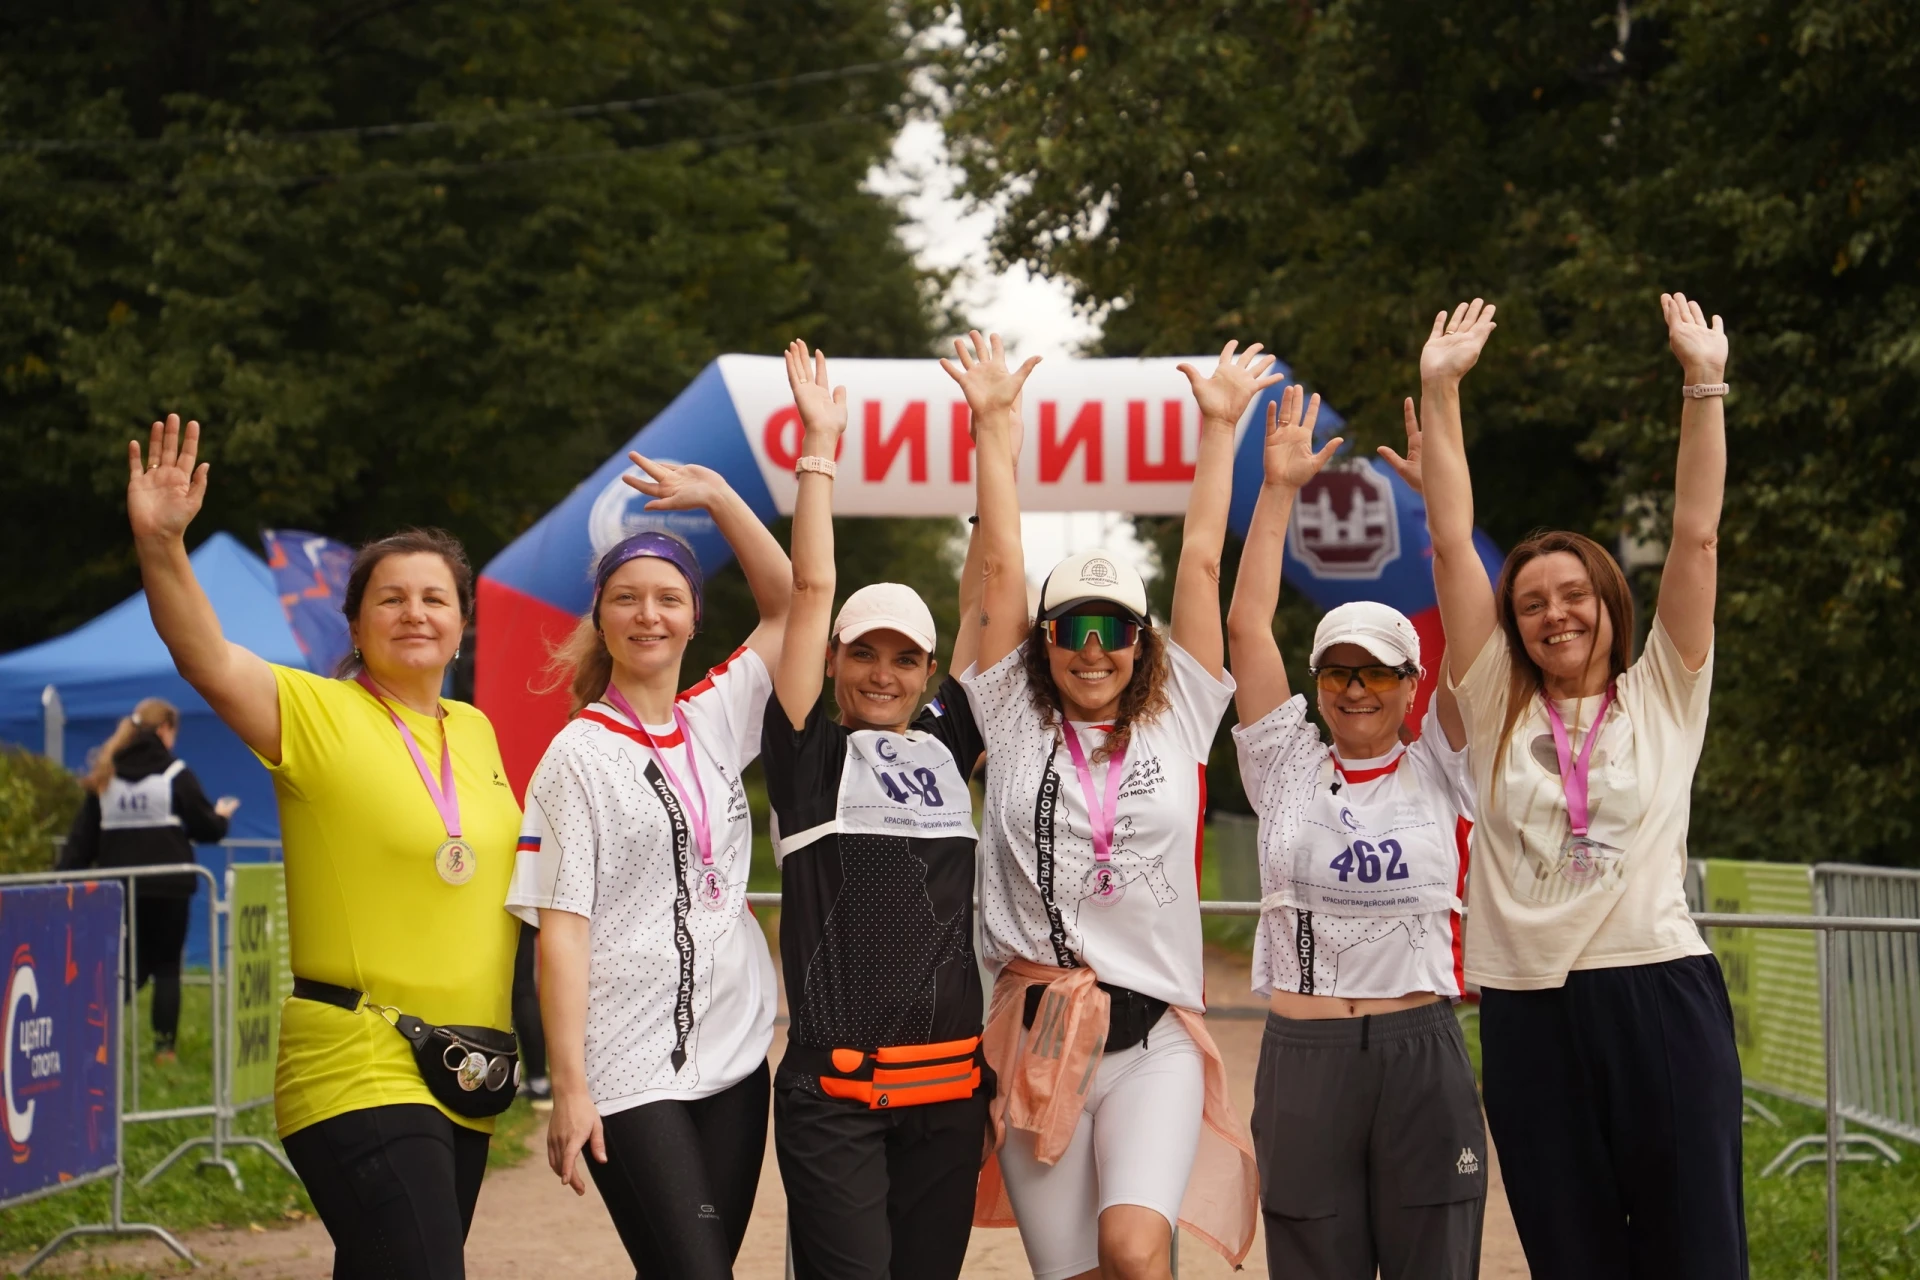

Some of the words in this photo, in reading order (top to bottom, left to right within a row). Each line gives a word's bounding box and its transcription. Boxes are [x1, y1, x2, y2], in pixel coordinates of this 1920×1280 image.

[654, 777, 685, 830] РАЙОНА
[1128, 779, 1154, 788] БОЛШЕ
[884, 816, 942, 828] КРАСНОГВЙСКИЙ
[943, 820, 962, 828] РАЙОН
[1039, 782, 1061, 930] КРАСОГВАРДЕЙСКОГО
[1329, 838, 1410, 884] 462
[675, 833, 692, 987] КРАСНОГВАДЕКОГО
[1322, 896, 1396, 908] КРАСНОГВАРДЕЙСКИЙ
[1397, 896, 1420, 905] РАЙОН
[20, 1016, 53, 1059] ЦЕНТР
[1457, 1163, 1479, 1175] Kappa
